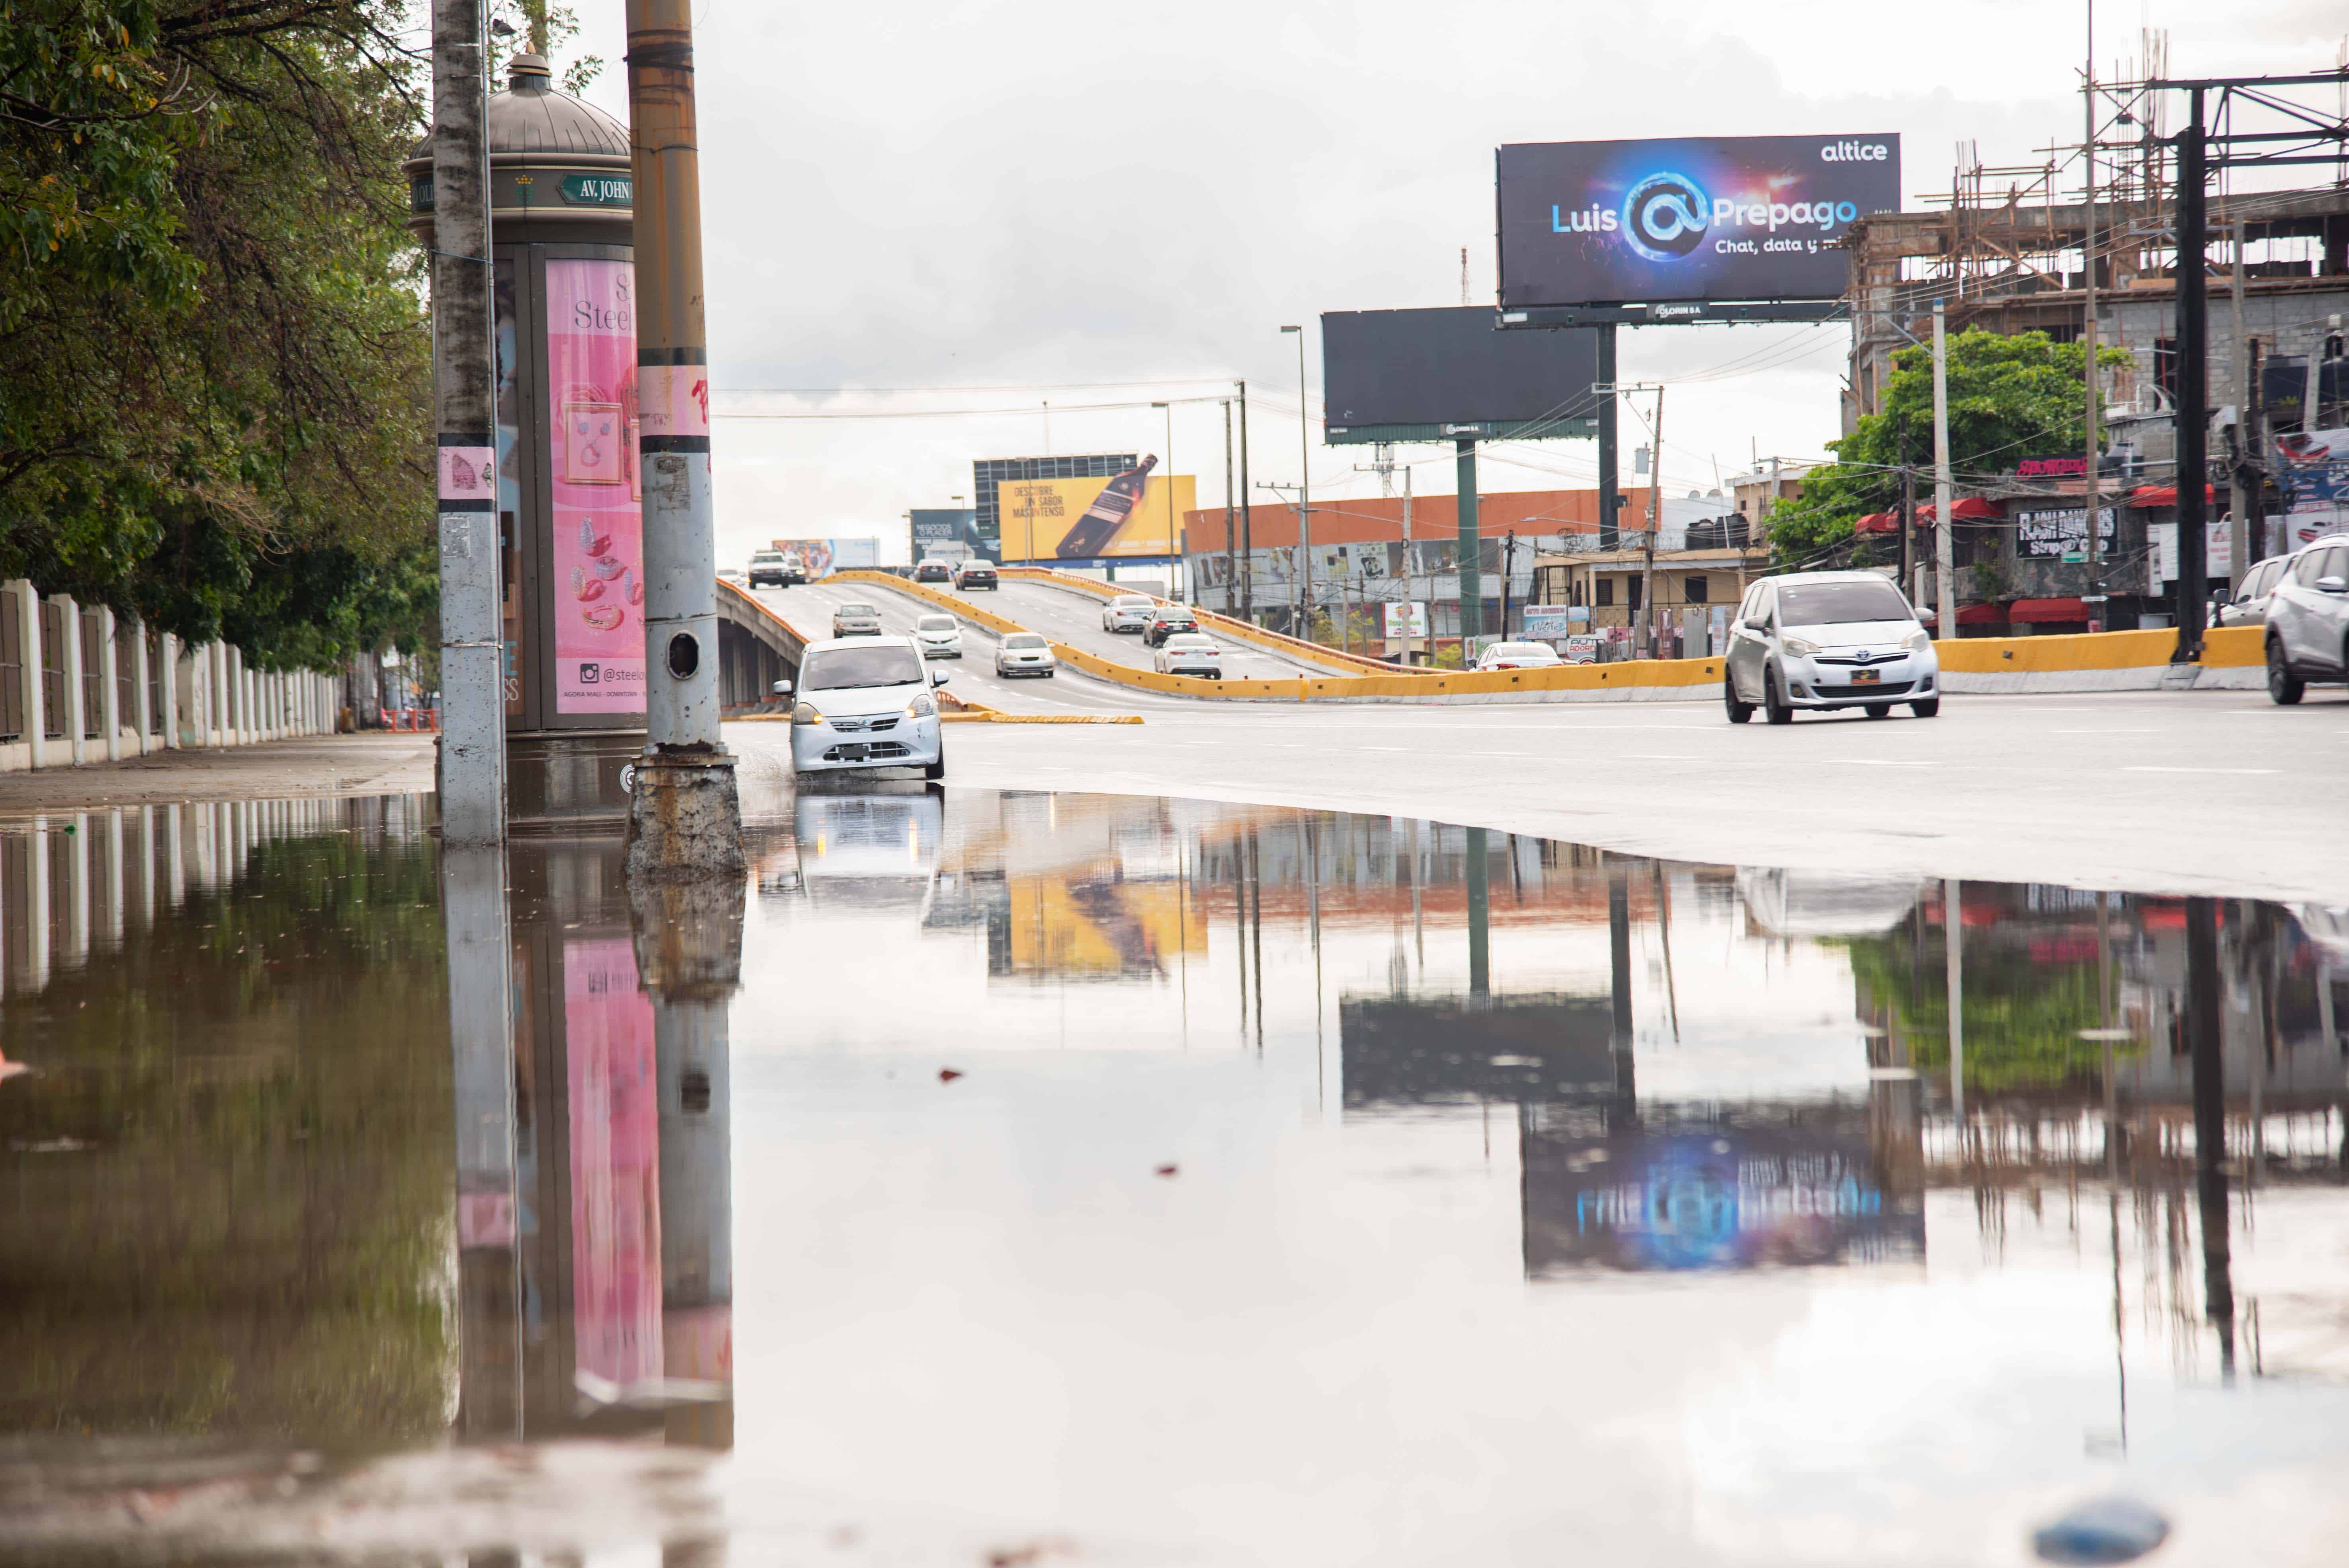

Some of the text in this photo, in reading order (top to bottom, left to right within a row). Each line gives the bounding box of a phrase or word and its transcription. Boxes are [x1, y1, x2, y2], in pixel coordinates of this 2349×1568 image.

[1821, 140, 1887, 161] altice
[580, 180, 597, 197] AV.
[599, 181, 629, 201] JOHN
[1553, 203, 1618, 232] Luis
[1713, 199, 1856, 232] Prepago
[1715, 239, 1758, 254] Chat,
[1763, 239, 1802, 252] data
